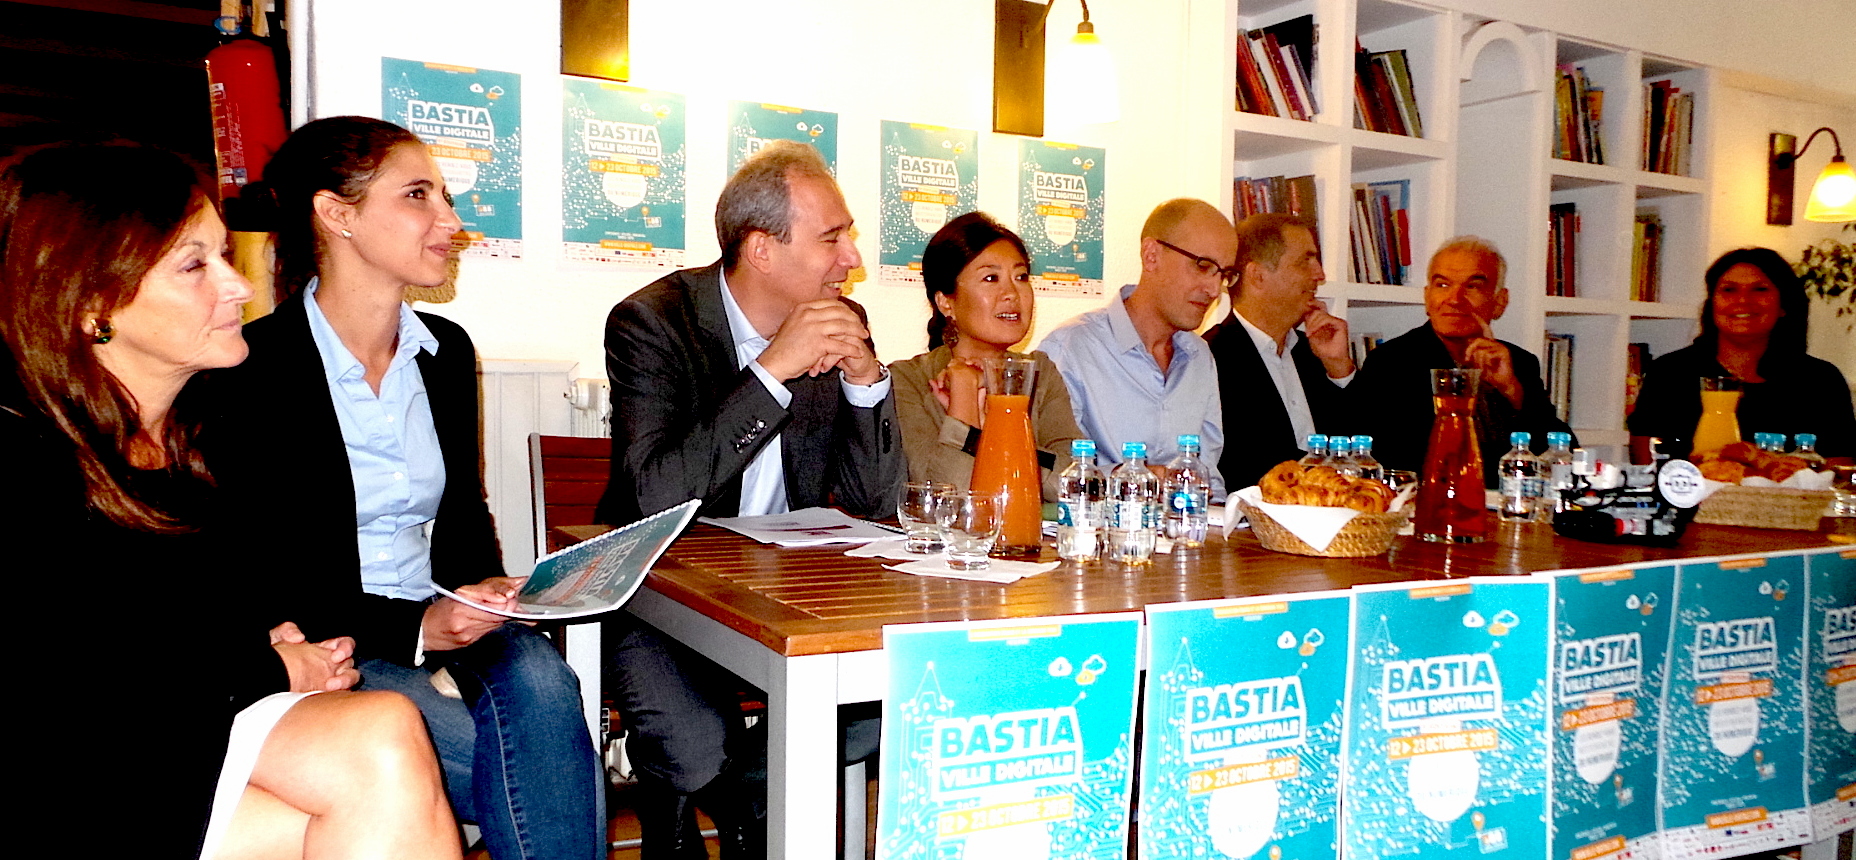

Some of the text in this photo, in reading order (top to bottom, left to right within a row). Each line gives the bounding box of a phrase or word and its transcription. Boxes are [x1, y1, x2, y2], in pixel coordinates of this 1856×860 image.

[412, 103, 489, 126] BASTIA
[413, 123, 489, 139] VILLE DIGITALE
[589, 123, 657, 143] BASTIA
[442, 148, 471, 158] OCTOBRE
[590, 141, 657, 156] VILLE DIGITALE
[902, 159, 955, 175] BASTIA
[902, 174, 922, 184] VILLE
[1037, 175, 1084, 190] BASTIA
[1037, 189, 1055, 198] VILLE
[1700, 622, 1772, 650] BASTIA
[1566, 639, 1637, 672] BASTIA
[1388, 660, 1493, 694] BASTIA
[1192, 684, 1299, 724] BASTIA
[1389, 693, 1494, 718] VILLE DIGITALE
[940, 715, 1075, 759] BASTIA
[1192, 719, 1299, 751] VILLE DIGITALE
[1389, 731, 1494, 756] 12 23 OCTOBRE 2015
[941, 754, 1074, 788] VILLE DIGITALE
[1191, 758, 1296, 791] 12 23 OCTOBRE 2015
[941, 798, 1071, 834] 12 23 OCTOBRE 2015
